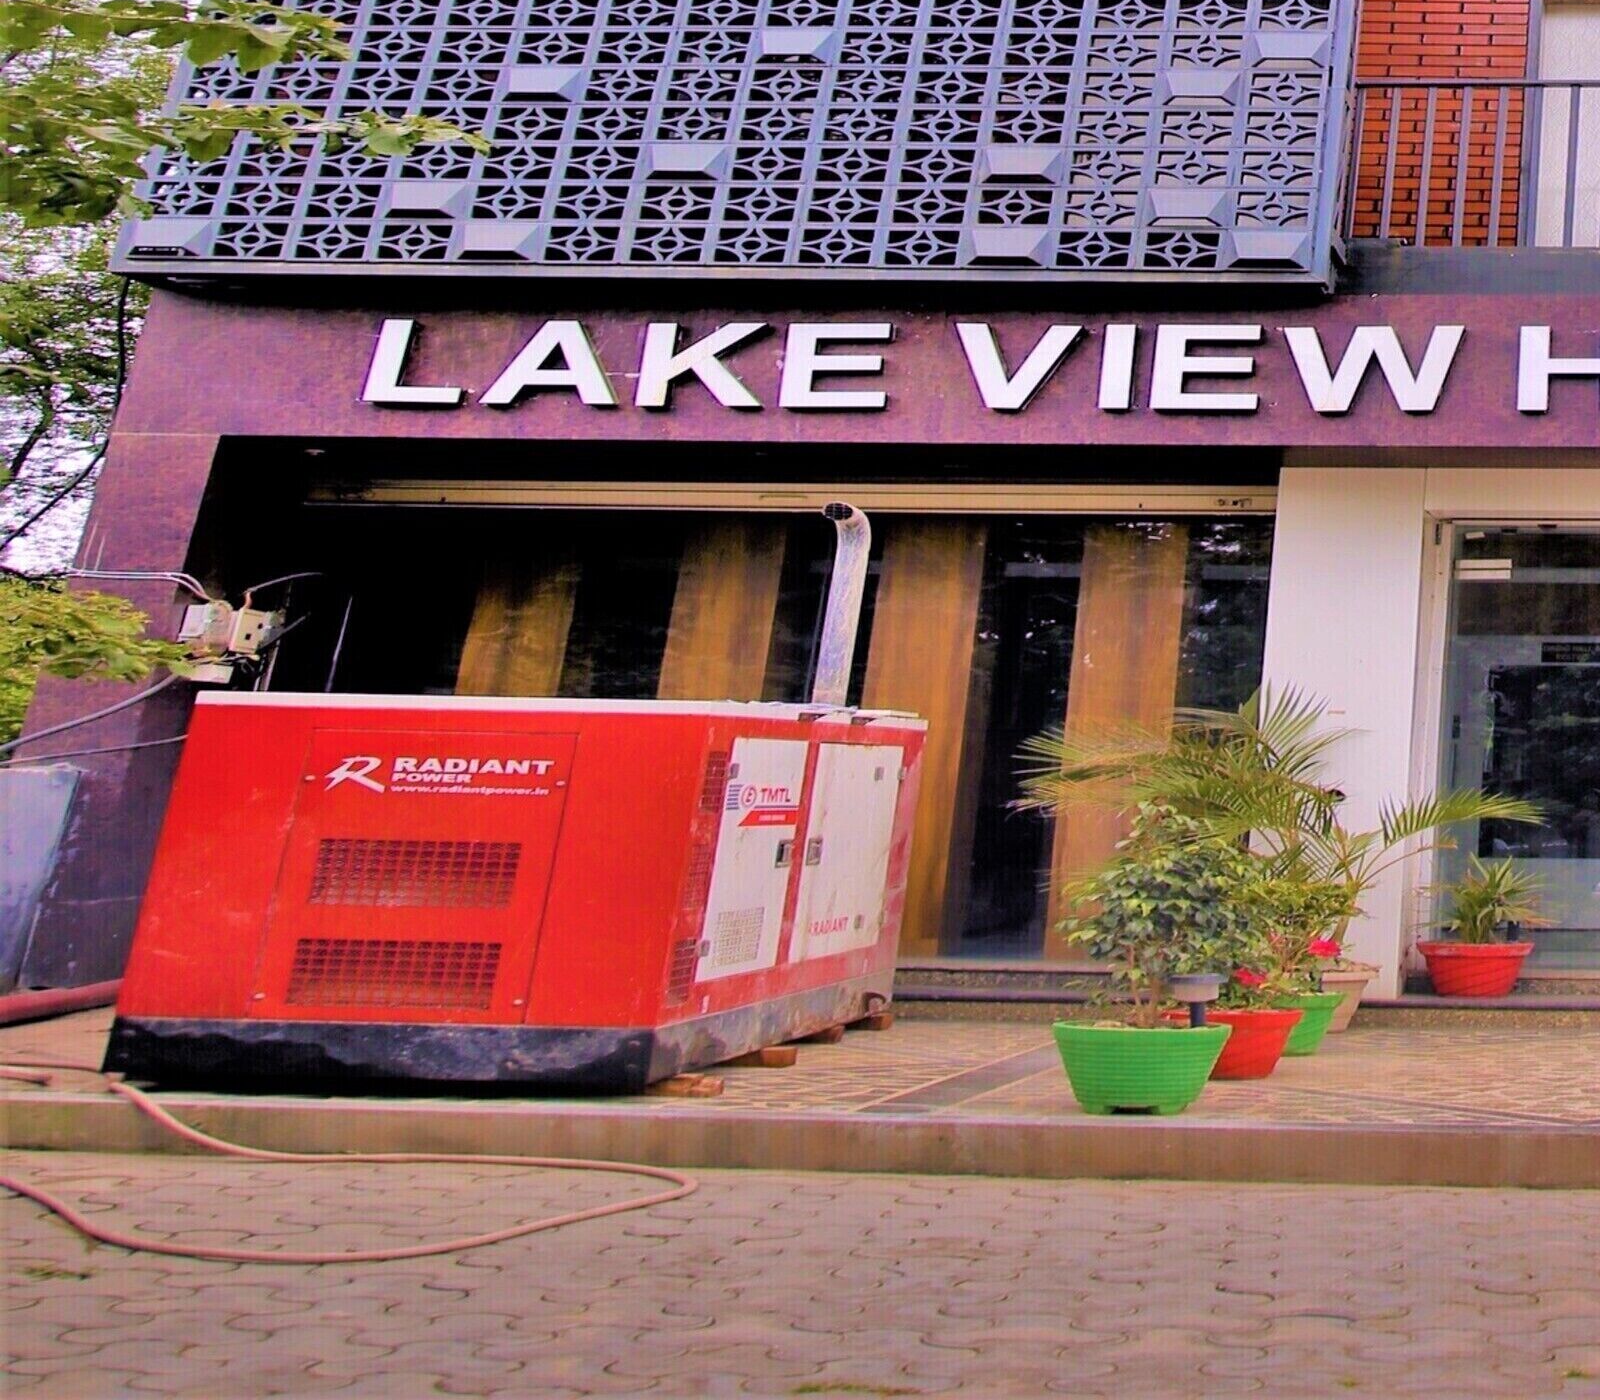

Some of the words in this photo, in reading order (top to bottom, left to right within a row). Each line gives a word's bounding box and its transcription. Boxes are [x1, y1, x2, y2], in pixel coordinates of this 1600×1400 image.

[362, 318, 891, 407] LAKE
[956, 323, 1465, 411] VIEW
[393, 757, 555, 775] RADIANT
[391, 772, 473, 784] POWER
[390, 783, 549, 797] www.radiantpower.in
[761, 788, 791, 803] TMTL
